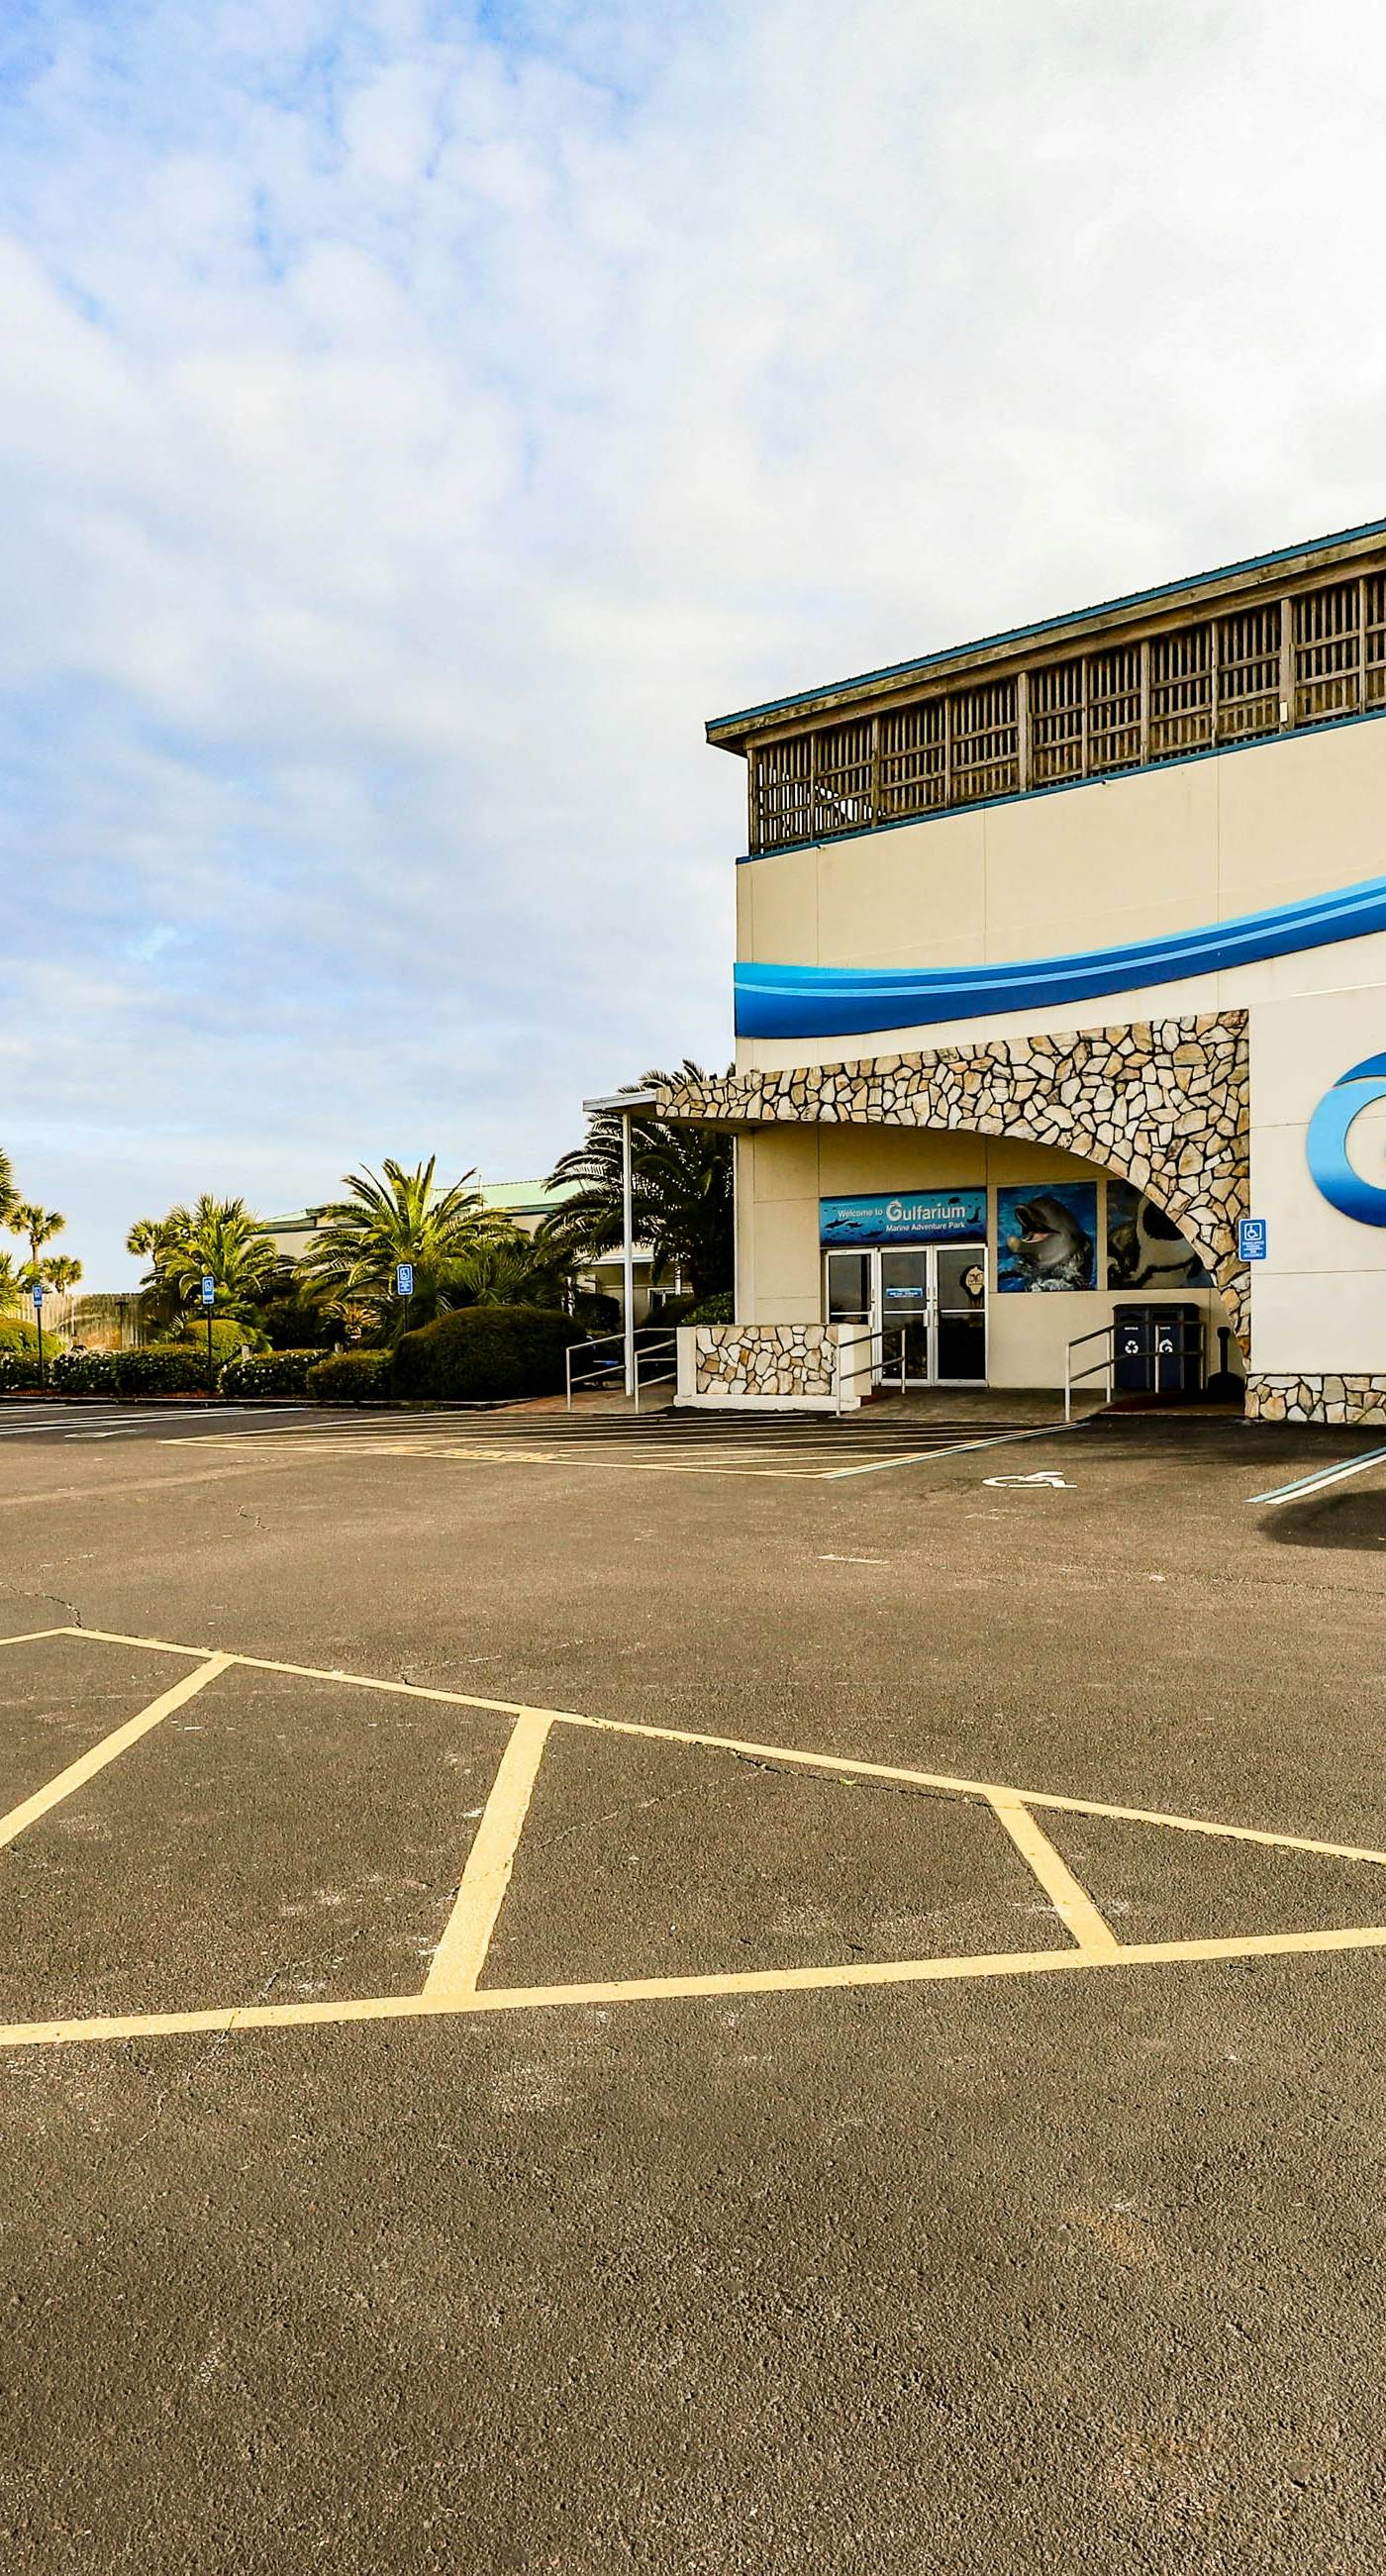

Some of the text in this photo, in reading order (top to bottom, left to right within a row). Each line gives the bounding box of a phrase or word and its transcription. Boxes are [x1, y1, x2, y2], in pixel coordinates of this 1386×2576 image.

[838, 1200, 966, 1221] Welcome to Gulfarium
[911, 1222, 947, 1231] Adventure
